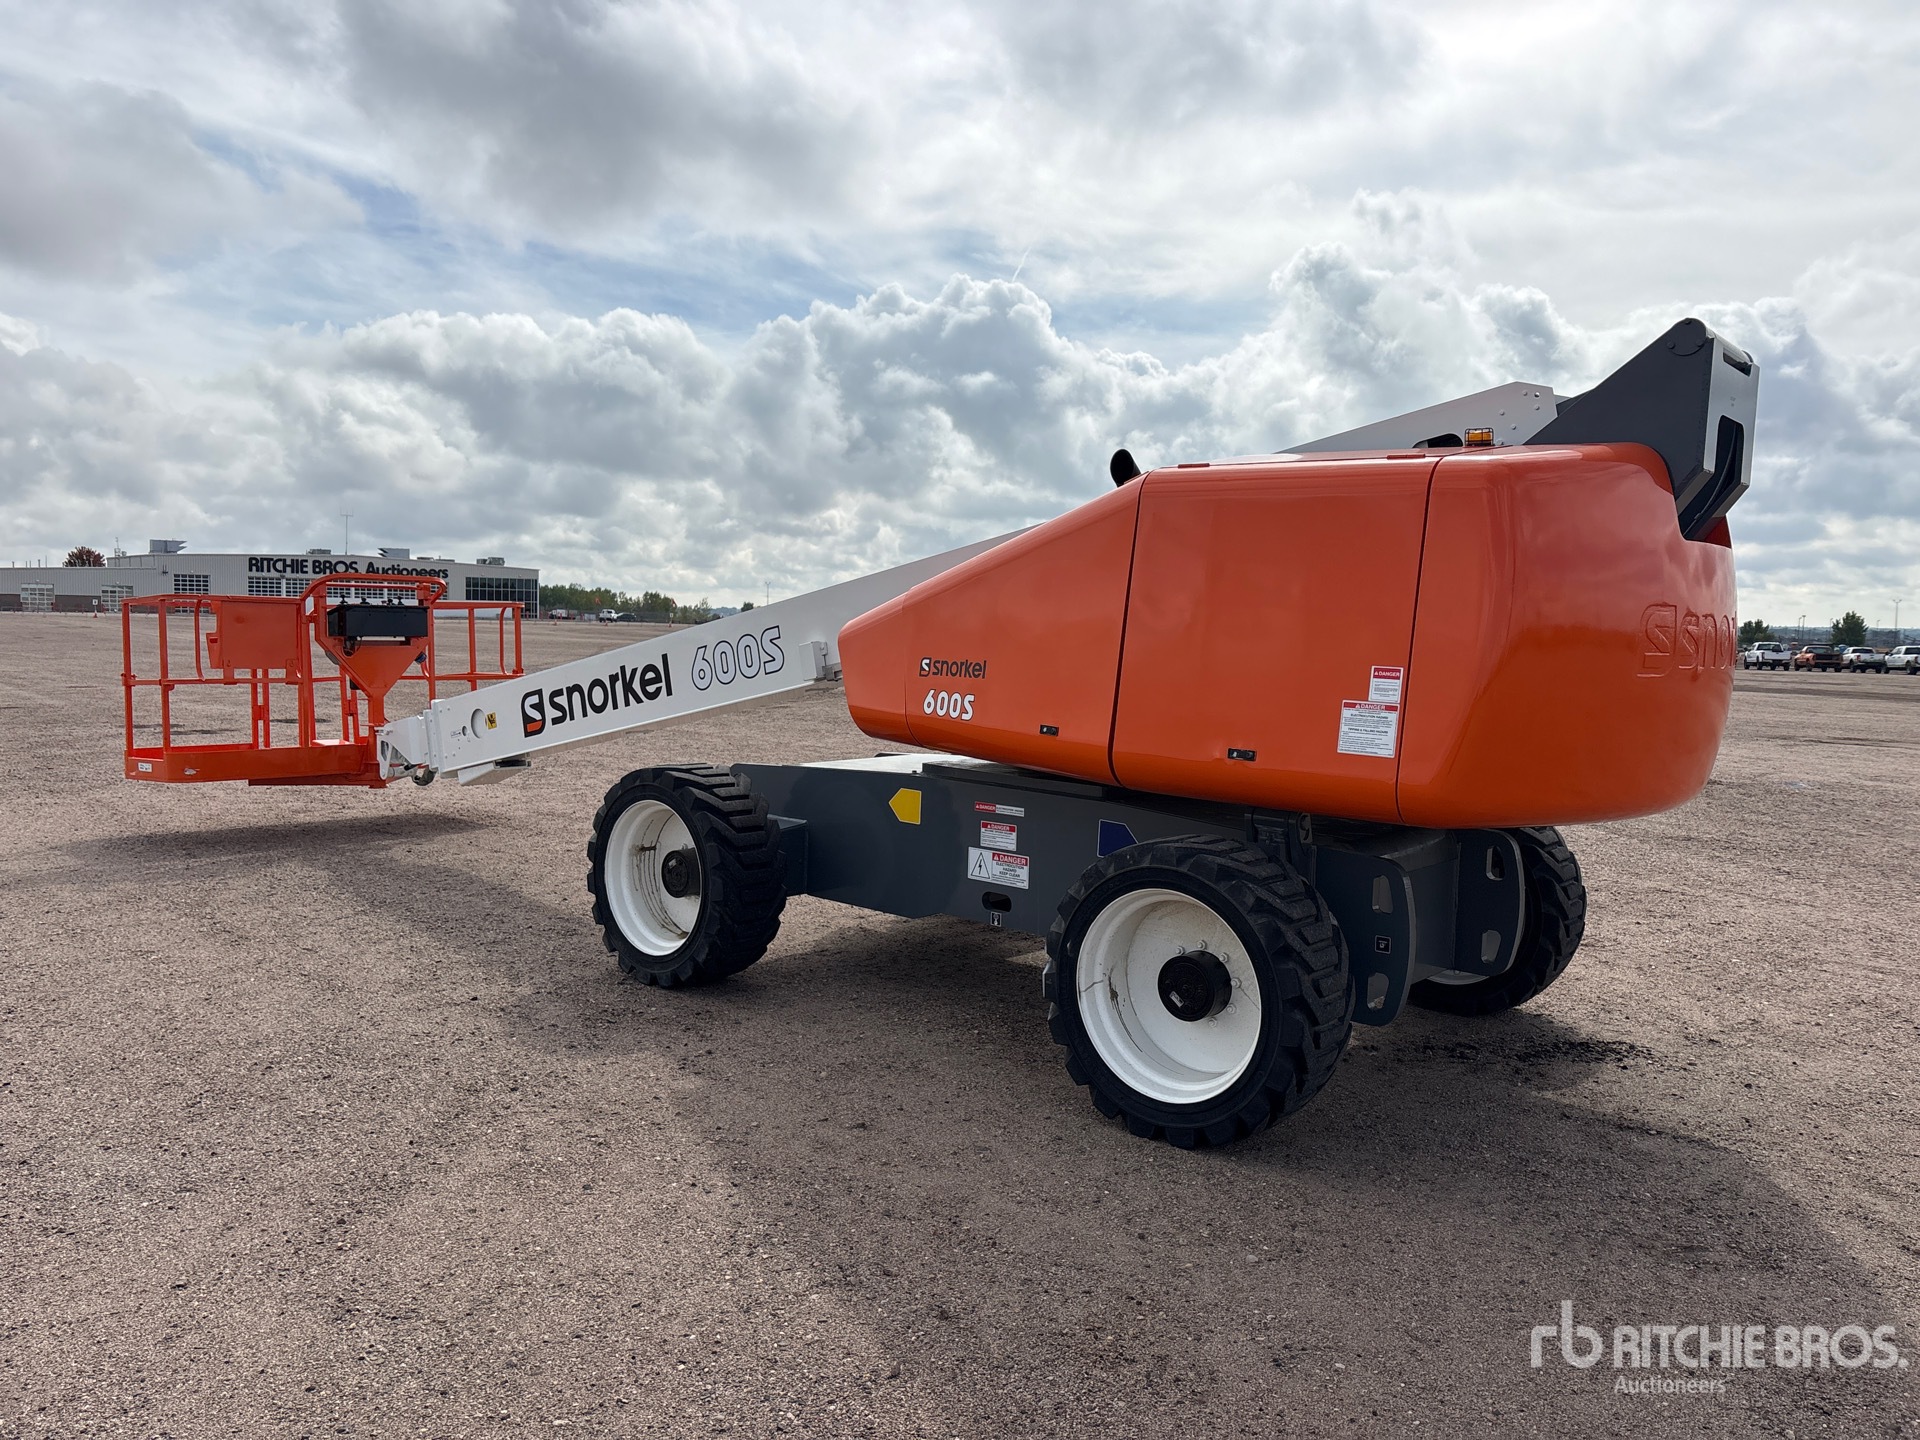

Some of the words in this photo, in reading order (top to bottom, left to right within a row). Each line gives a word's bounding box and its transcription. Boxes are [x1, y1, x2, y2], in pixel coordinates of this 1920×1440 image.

[248, 557, 308, 574] RITCHIE
[366, 561, 449, 579] Auctioneers
[549, 653, 673, 726] snorkel
[691, 625, 785, 691] 600S
[932, 659, 987, 679] snorkel
[923, 688, 976, 721] 600S
[991, 823, 1010, 831] DANGER
[999, 855, 1026, 865] DANGER
